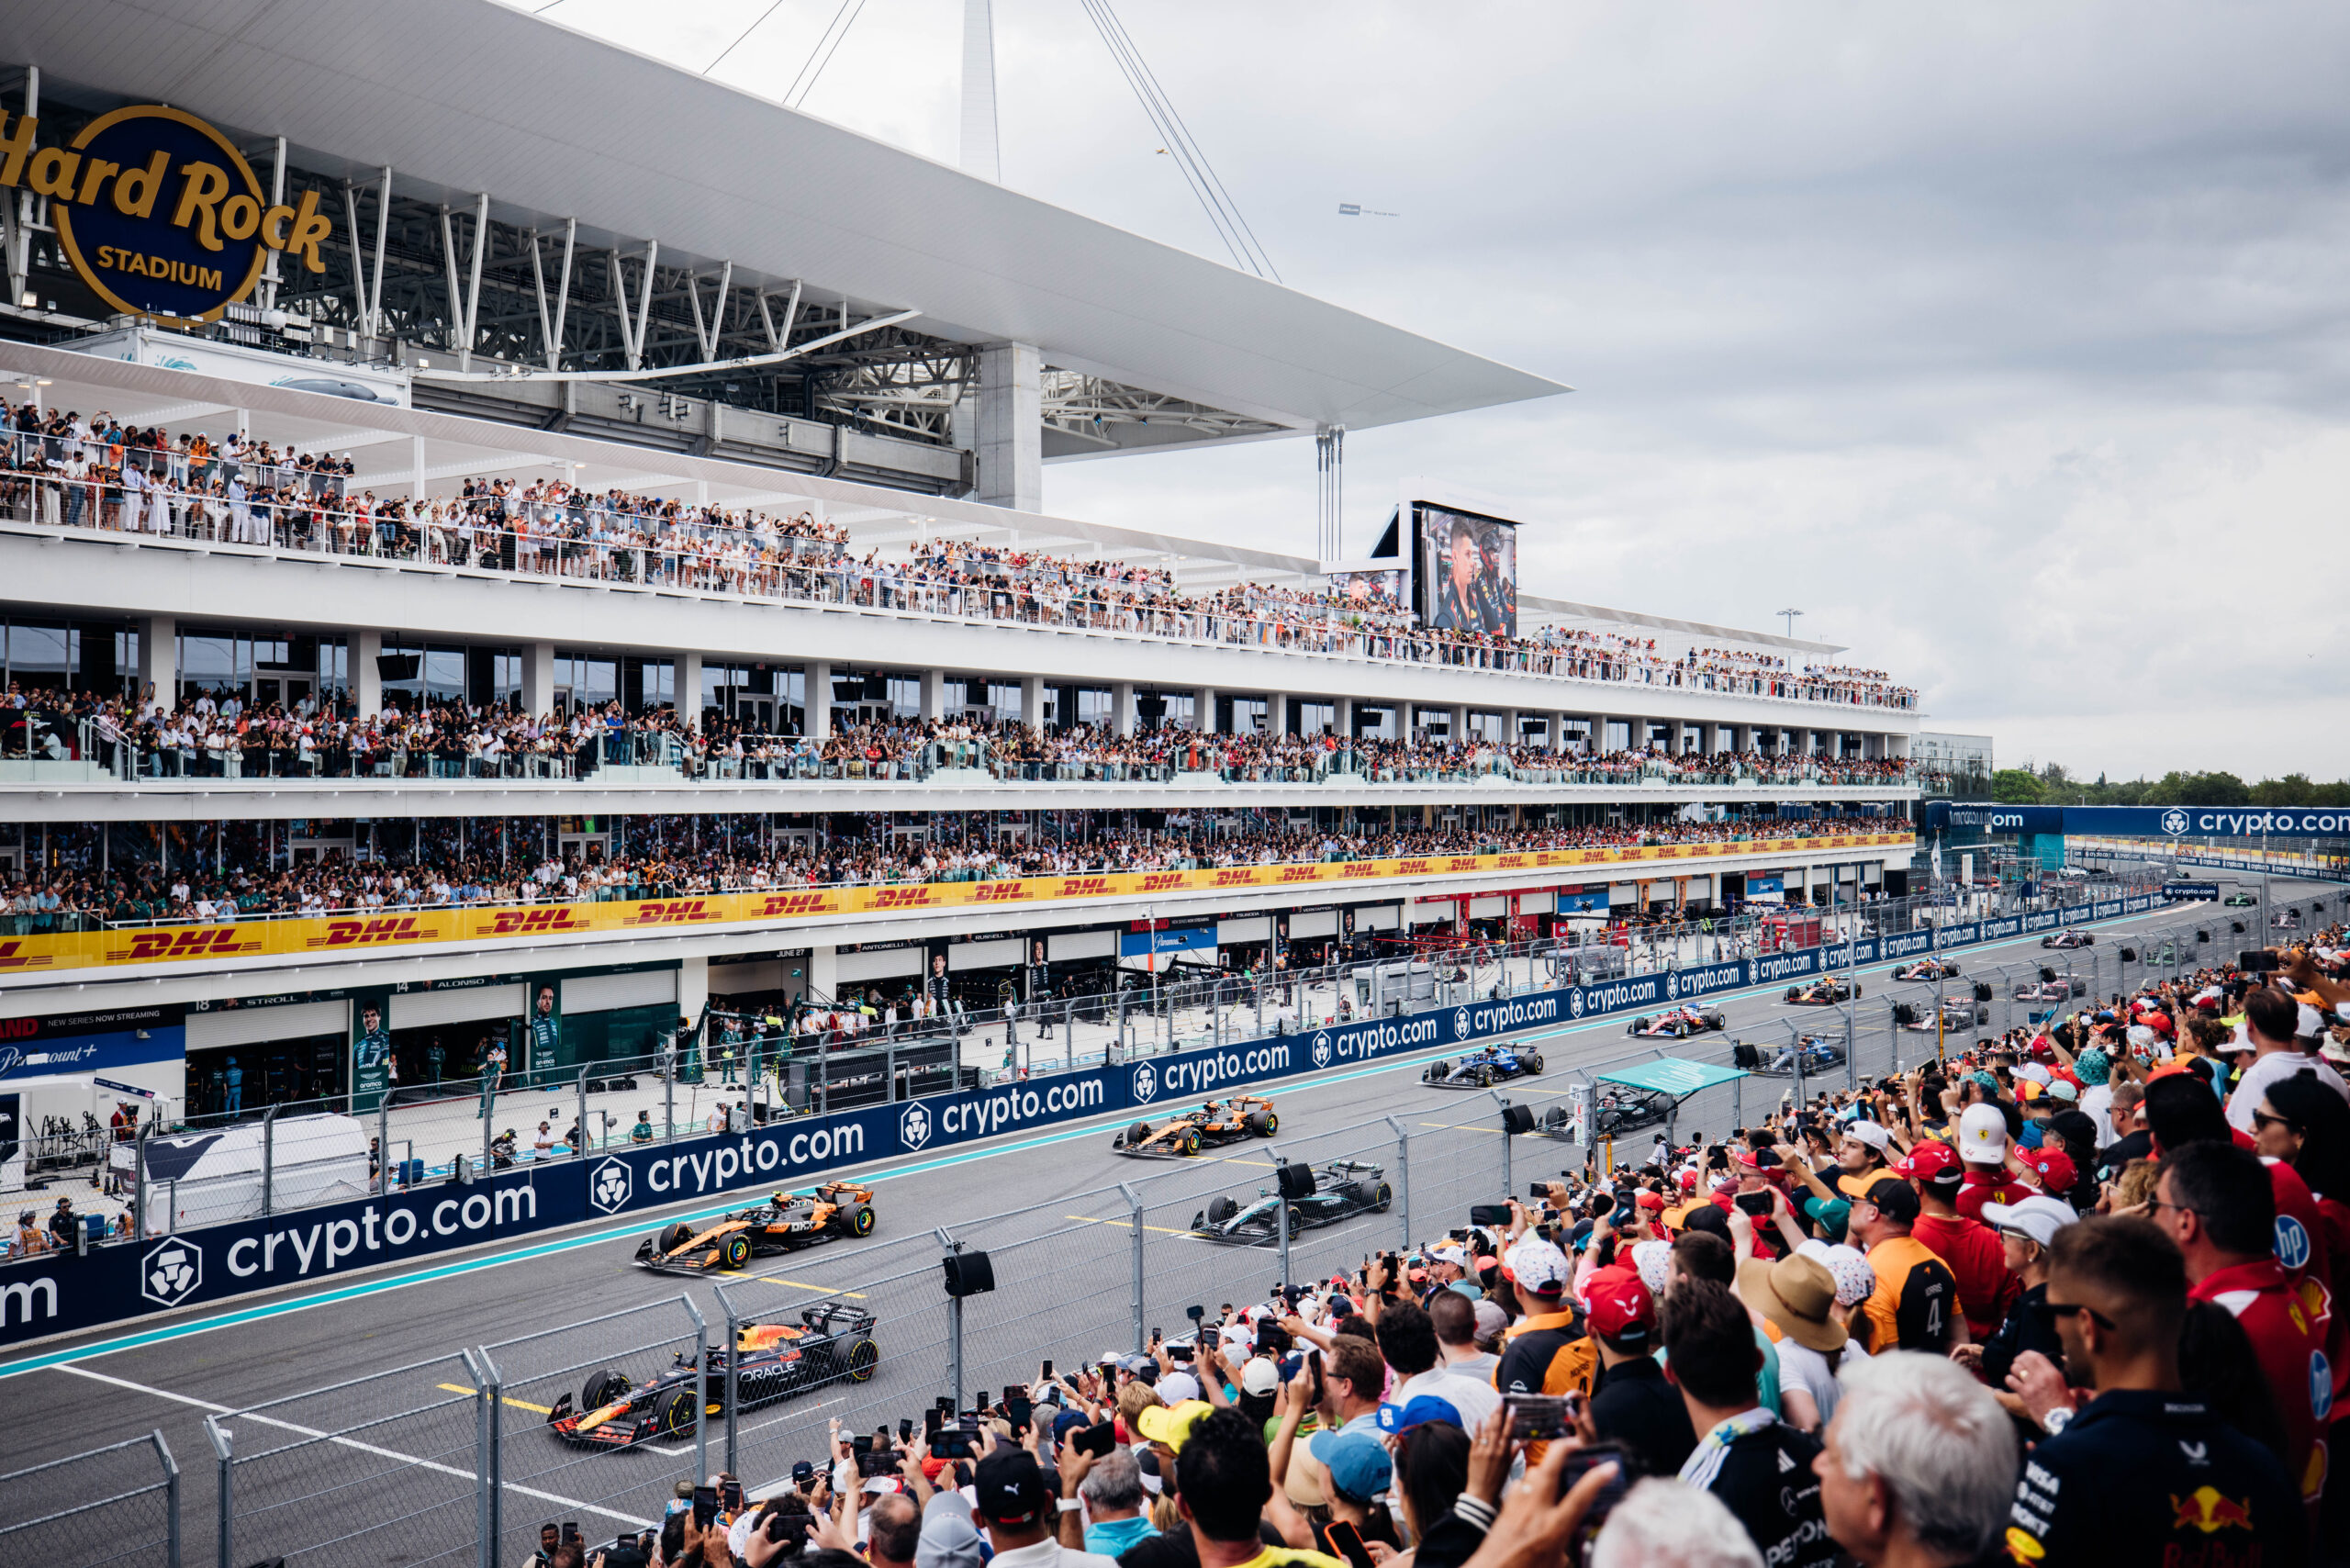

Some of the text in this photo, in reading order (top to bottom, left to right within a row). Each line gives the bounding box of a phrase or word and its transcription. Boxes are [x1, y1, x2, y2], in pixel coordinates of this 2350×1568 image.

[172, 159, 332, 274] Rock
[96, 244, 223, 293] STADIUM
[1583, 851, 1606, 863] DHL
[1622, 849, 1641, 860] DHL
[1658, 847, 1677, 857] DHL
[1691, 846, 1709, 856] DHL
[1721, 844, 1740, 854] DHL
[1343, 863, 1374, 878] DHL
[1400, 860, 1428, 873] DHL
[1450, 858, 1478, 871] DHL
[1498, 856, 1524, 868] DHL
[1145, 873, 1186, 890] DHL
[1217, 870, 1255, 885] DHL
[1283, 867, 1317, 881] DHL
[975, 882, 1024, 901] DHL
[1064, 879, 1108, 896] DHL
[2174, 888, 2216, 896] crypto.com
[764, 894, 826, 913] DHL
[876, 888, 933, 907] DHL
[2128, 898, 2148, 913] crypto.com
[638, 901, 708, 922] DHL
[2065, 907, 2090, 924] crypto.com
[2098, 902, 2121, 918] crypto.com
[494, 909, 578, 933] DHL
[1131, 918, 1169, 932] MOBAND
[1986, 920, 2018, 938] crypto.com
[2027, 913, 2055, 931] crypto.com
[327, 918, 421, 945] DHL
[975, 933, 1005, 941] RUSSELL
[1941, 926, 1975, 946] crypto.com
[130, 929, 242, 959] DHL
[861, 942, 904, 951] ANTONELLI
[1888, 935, 1927, 956] crypto.com
[777, 949, 795, 958] JUNE
[1829, 944, 1873, 965] crypt.com
[1761, 955, 1810, 978] crypto.com
[397, 981, 409, 992] 14
[438, 978, 485, 989] ALONSO
[1681, 966, 1739, 993] crypto.com
[196, 1001, 210, 1011] 18
[247, 996, 297, 1005] STROLL
[1587, 983, 1656, 1011] crypto.com
[49, 1010, 160, 1027] NEW SERIES NOW STREAMING
[1475, 997, 1557, 1031] crypto.com
[1337, 1018, 1438, 1058] crypto.com
[1165, 1044, 1290, 1091] crypto.com
[942, 1076, 1103, 1135] crypto.com
[648, 1122, 865, 1194] crypto.com
[227, 1184, 537, 1276] crypto.com
[2276, 1224, 2302, 1266] hp
[1927, 1298, 1942, 1337] 4
[800, 1334, 826, 1346] HONDA
[739, 1361, 796, 1383] ORACLE
[1380, 1408, 1393, 1428] 55
[2025, 1459, 2060, 1495] VISA
